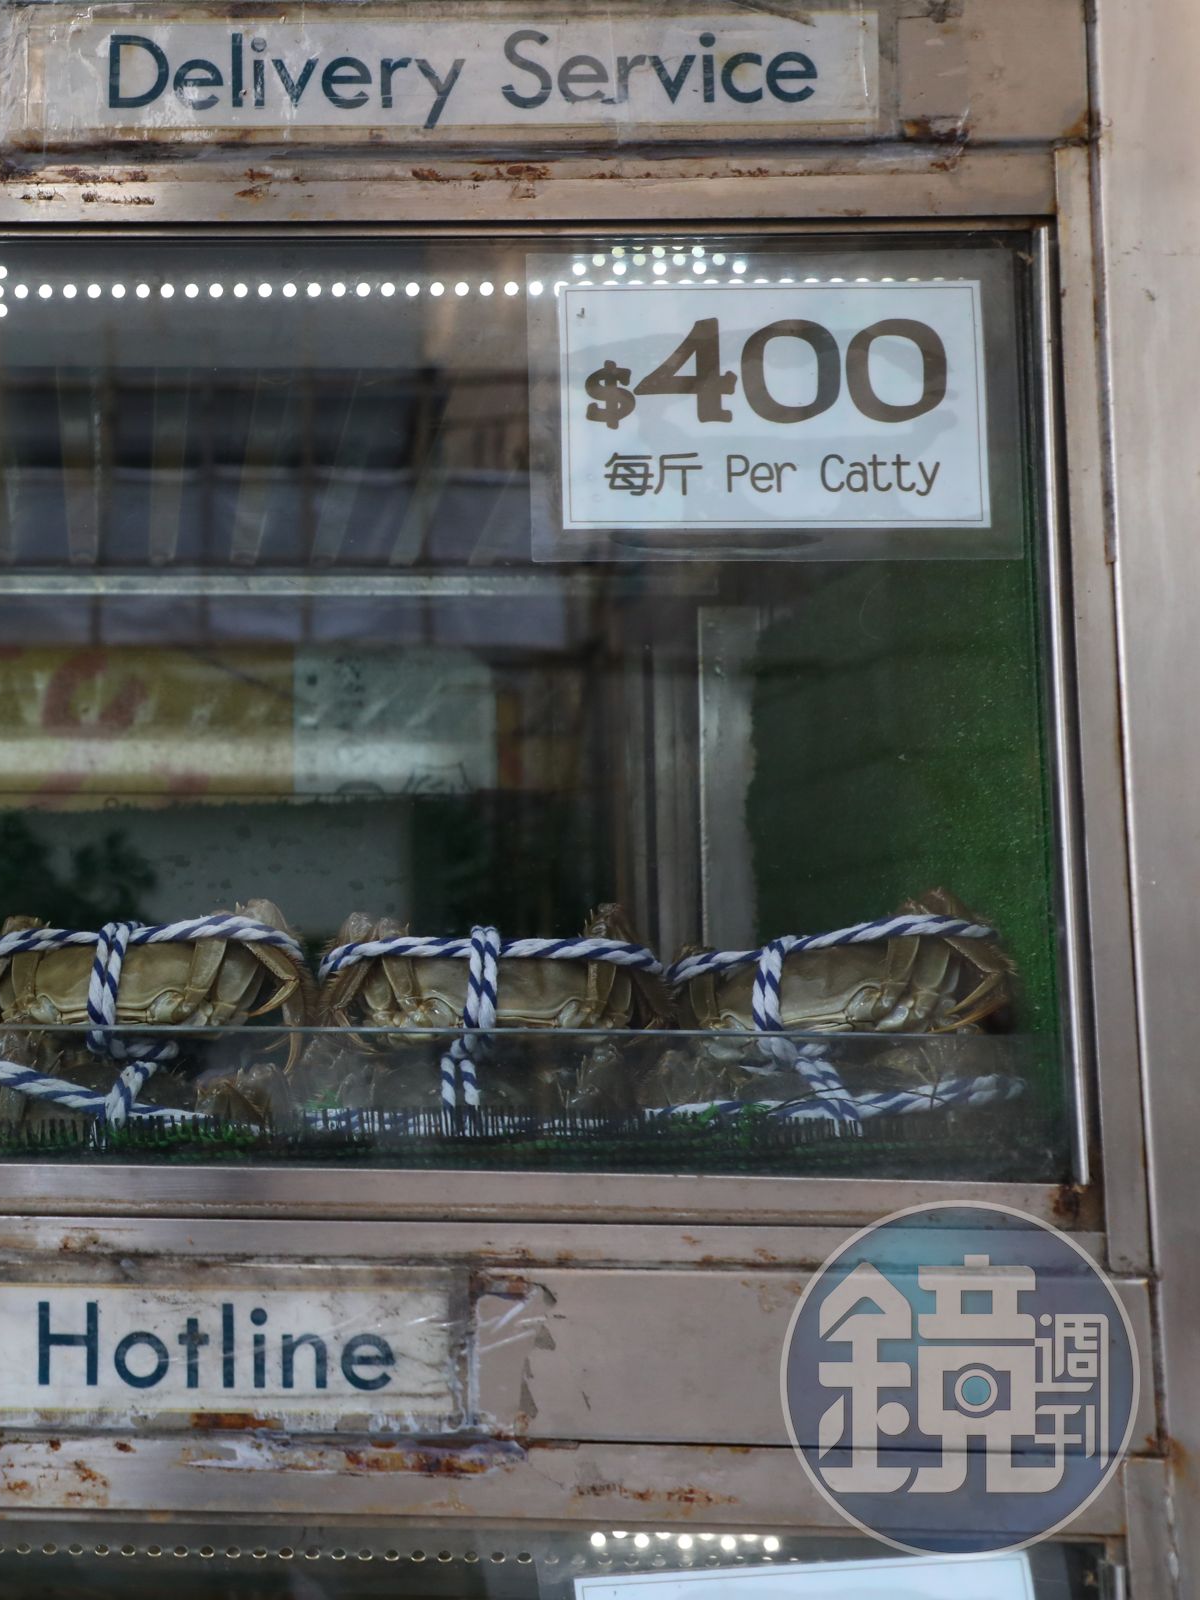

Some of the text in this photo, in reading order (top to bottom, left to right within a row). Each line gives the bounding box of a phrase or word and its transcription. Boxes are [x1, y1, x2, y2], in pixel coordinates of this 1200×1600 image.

[108, 30, 818, 129] Delivery Service
[585, 317, 948, 429] $400
[604, 452, 941, 497] 每斤 Per Catty
[37, 1301, 396, 1391] Hotline
